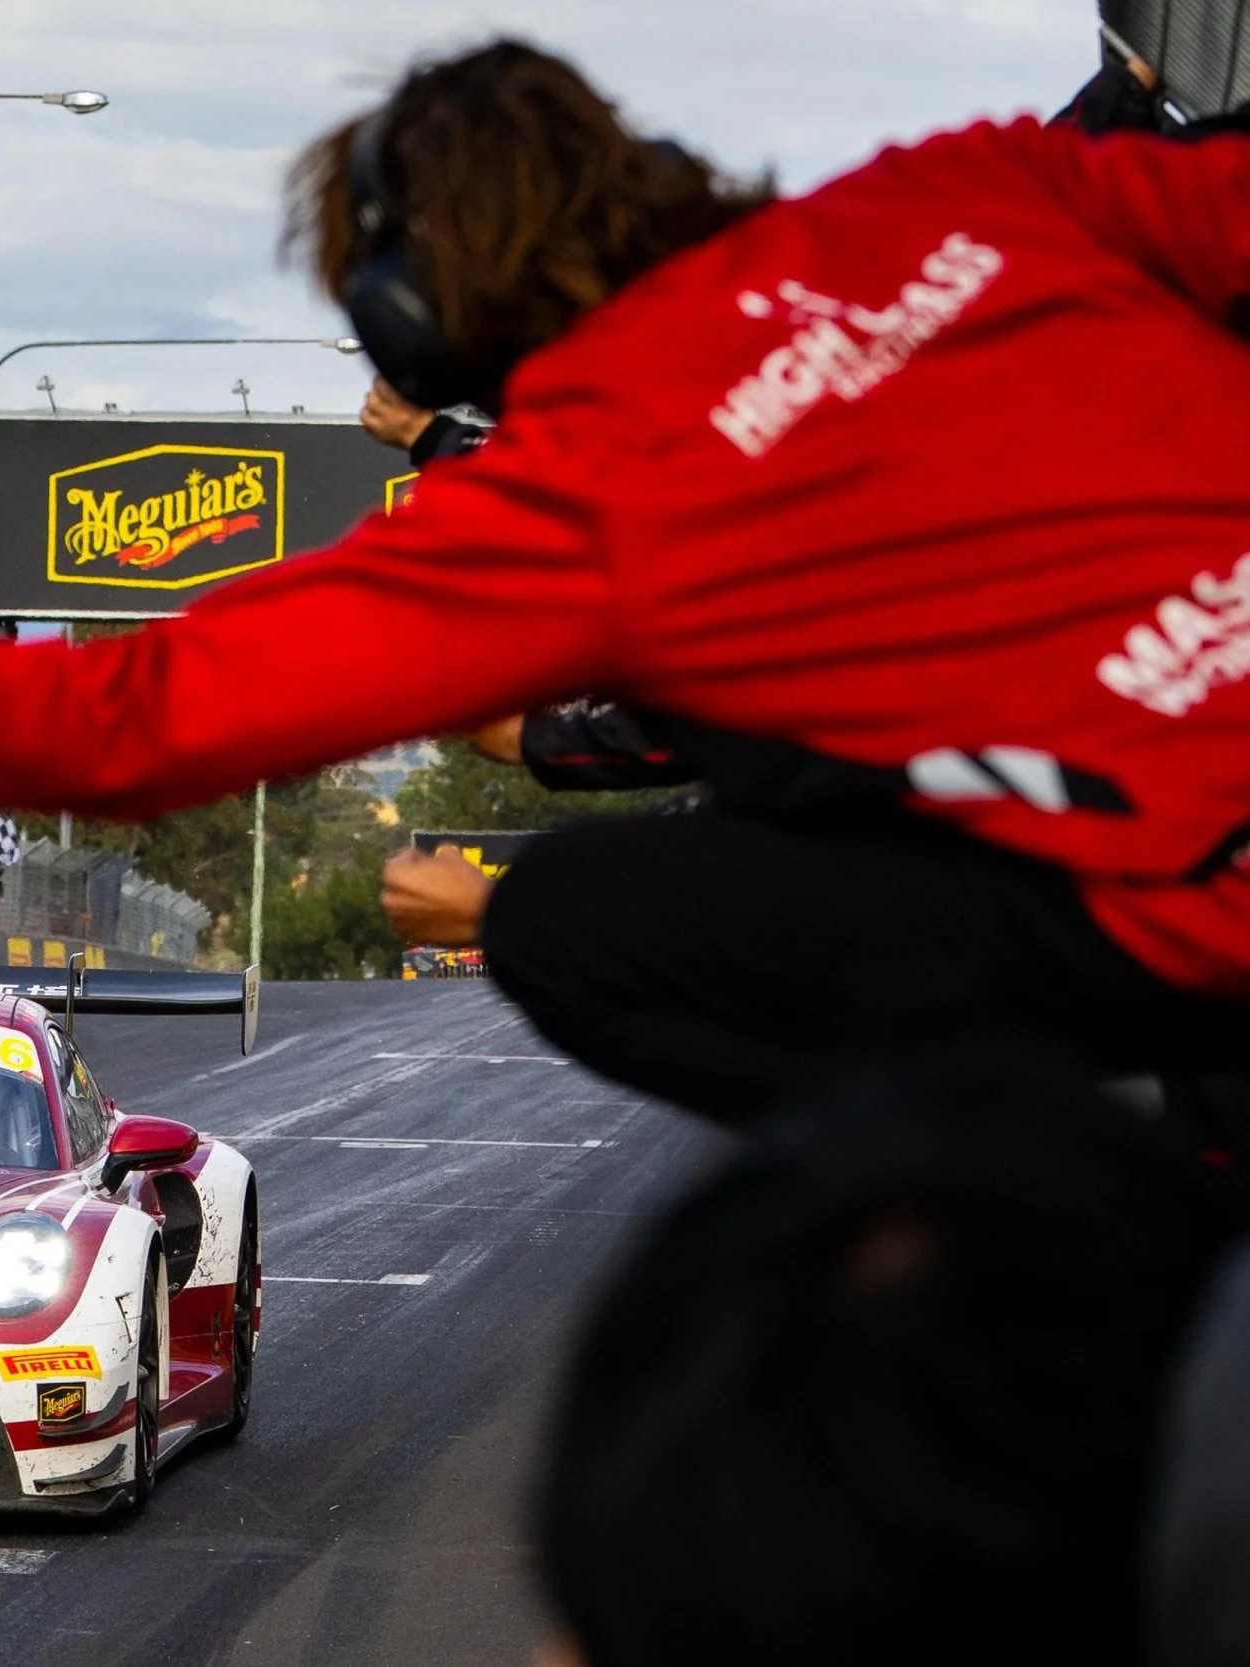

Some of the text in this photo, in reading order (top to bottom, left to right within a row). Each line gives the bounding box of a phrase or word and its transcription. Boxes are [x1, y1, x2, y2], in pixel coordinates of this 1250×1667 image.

[64, 461, 265, 565] Meguiar's
[2, 1351, 94, 1374] PIRELLI
[44, 1389, 81, 1417] Meguiar's
